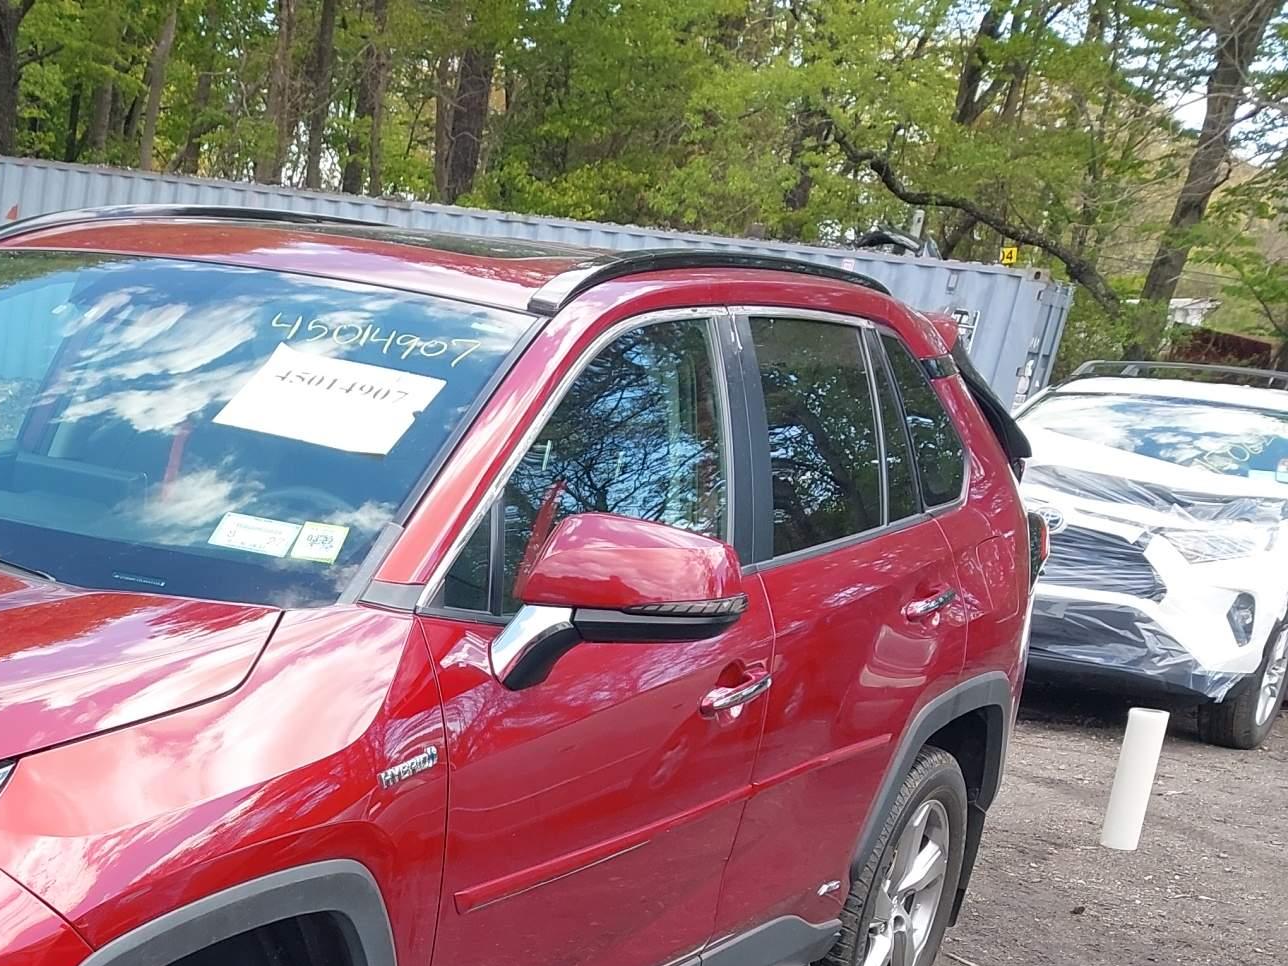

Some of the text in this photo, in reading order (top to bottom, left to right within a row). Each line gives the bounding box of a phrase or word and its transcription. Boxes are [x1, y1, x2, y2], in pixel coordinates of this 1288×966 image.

[271, 312, 482, 367] 45014907
[274, 369, 409, 404] 45014907
[377, 751, 431, 789] HYBRID
